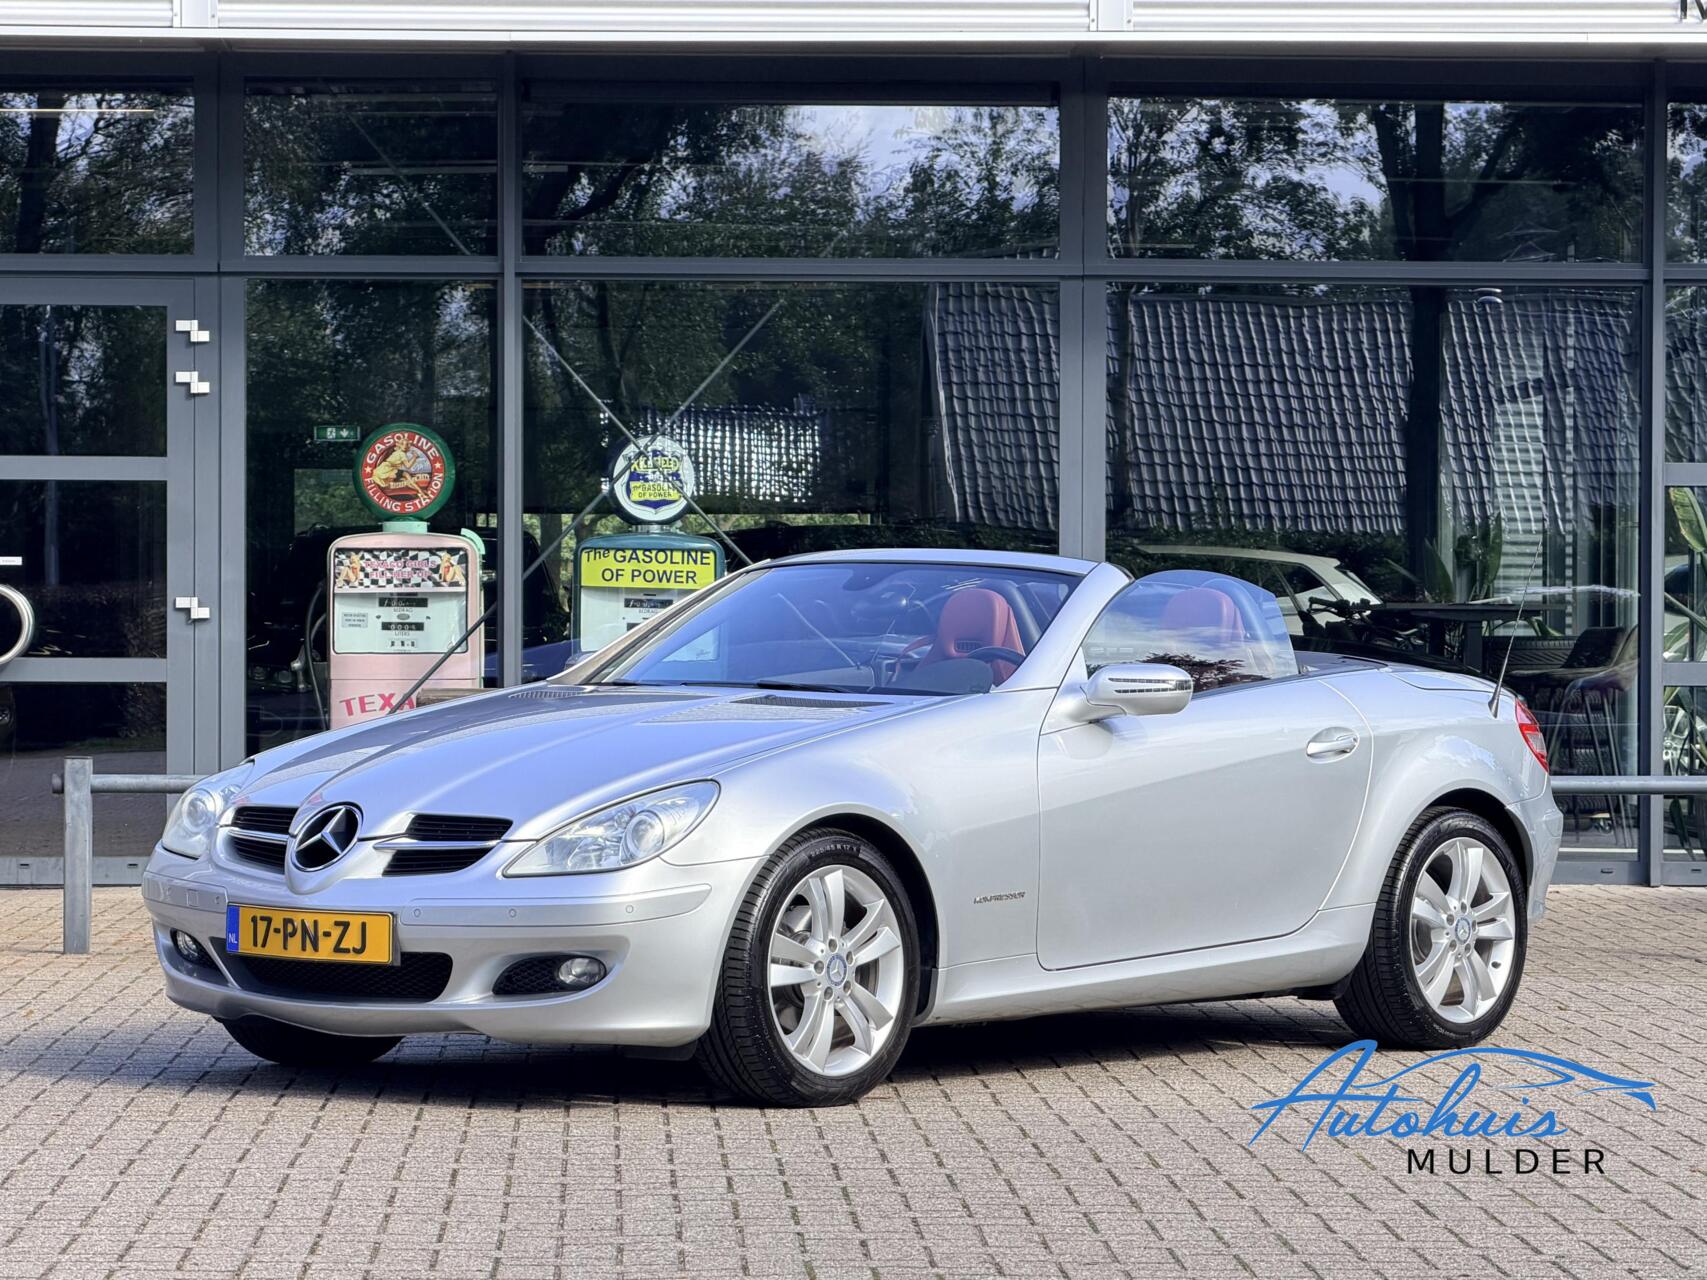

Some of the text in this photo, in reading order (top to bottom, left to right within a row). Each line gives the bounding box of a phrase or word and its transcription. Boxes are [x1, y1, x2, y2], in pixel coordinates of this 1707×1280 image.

[366, 433, 439, 464] GASOLINE
[365, 472, 444, 512] FILLING STATION
[584, 549, 711, 565] The GASOLINE
[601, 568, 697, 584] OF POWER
[228, 933, 238, 944] NL
[250, 915, 367, 955] 17-PN-ZJ
